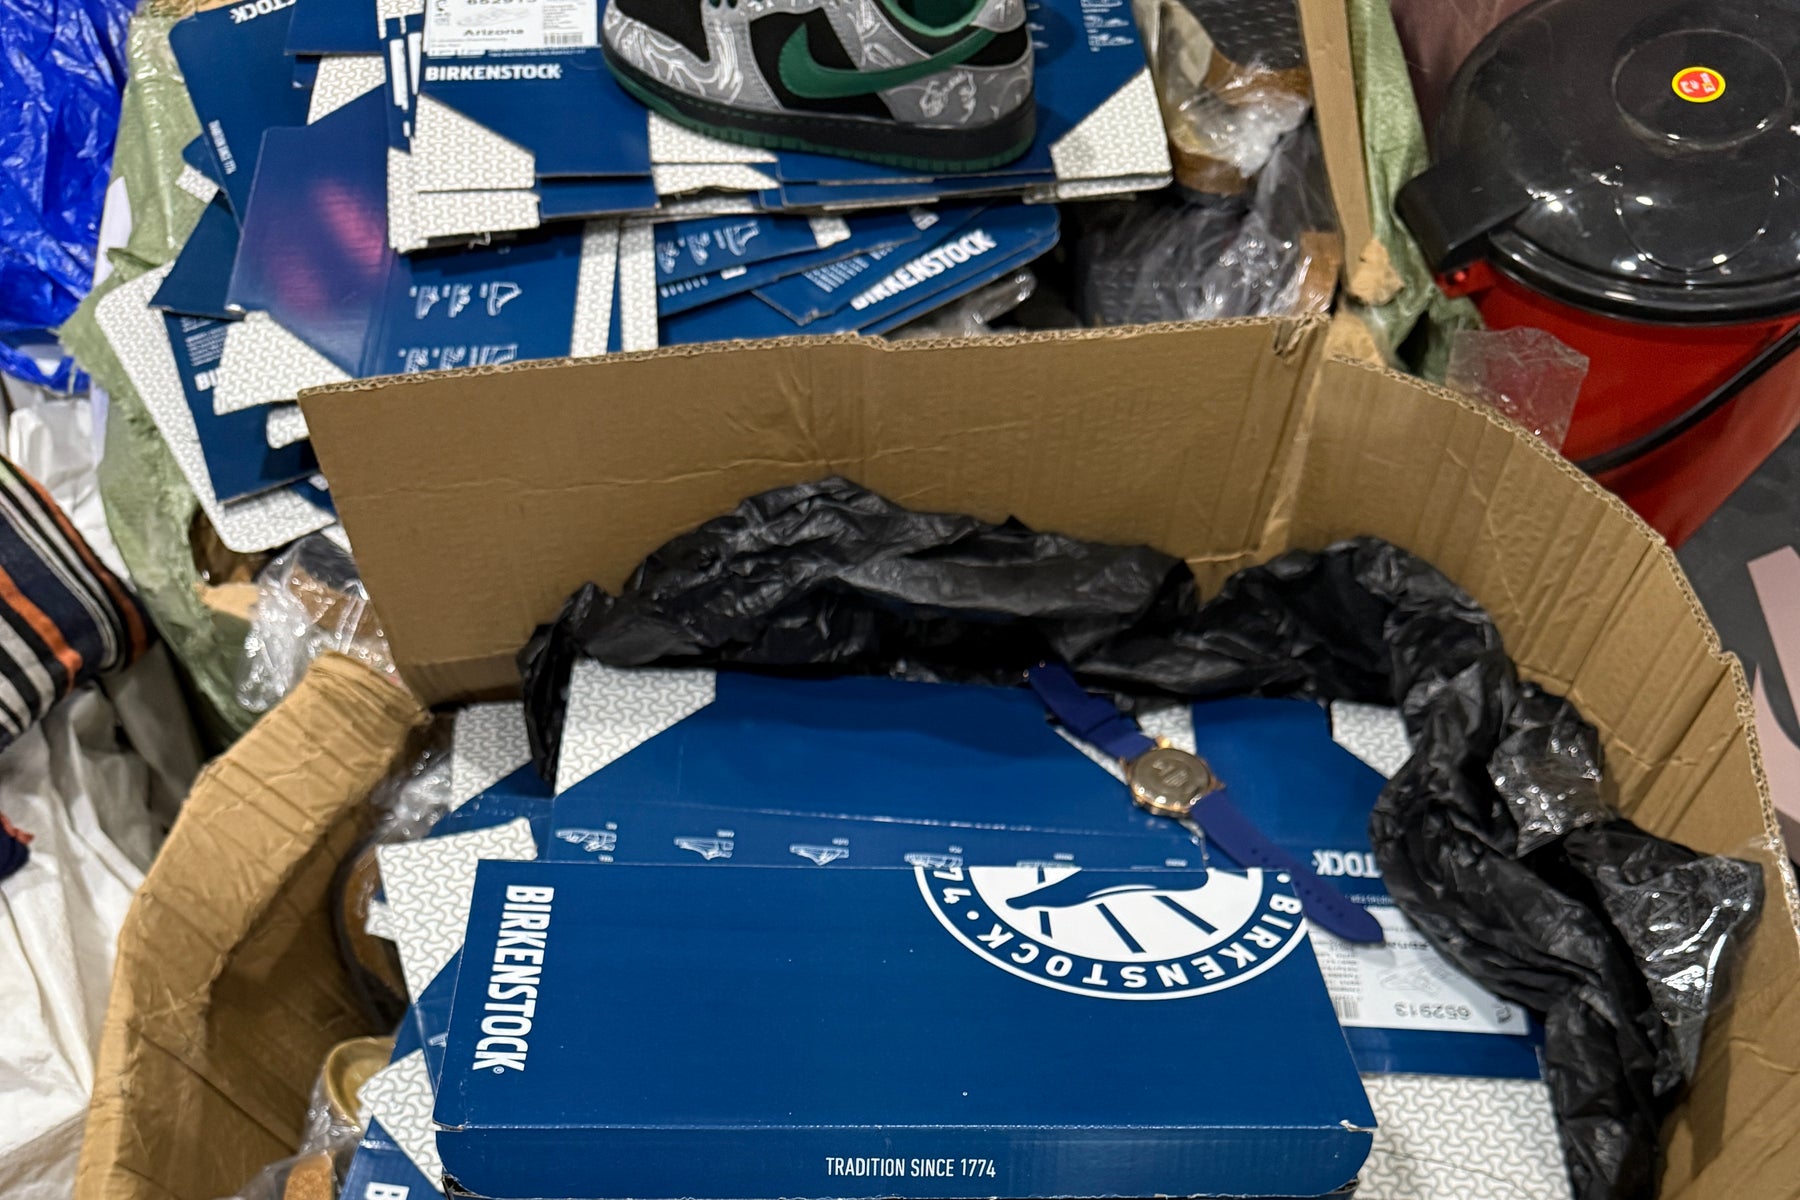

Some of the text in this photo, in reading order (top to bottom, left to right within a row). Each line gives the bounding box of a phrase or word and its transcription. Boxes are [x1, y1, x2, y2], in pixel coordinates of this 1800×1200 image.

[231, 0, 296, 23] TOCK
[463, 28, 524, 36] Arizona
[425, 64, 561, 81] BIRKENSTOCK
[977, 892, 1303, 989] BIRKENSTOCK
[472, 885, 554, 1071] BIRKENSTOCK
[1394, 1001, 1471, 1021] 652913
[826, 1157, 996, 1178] TRADITION SINCE 1774
